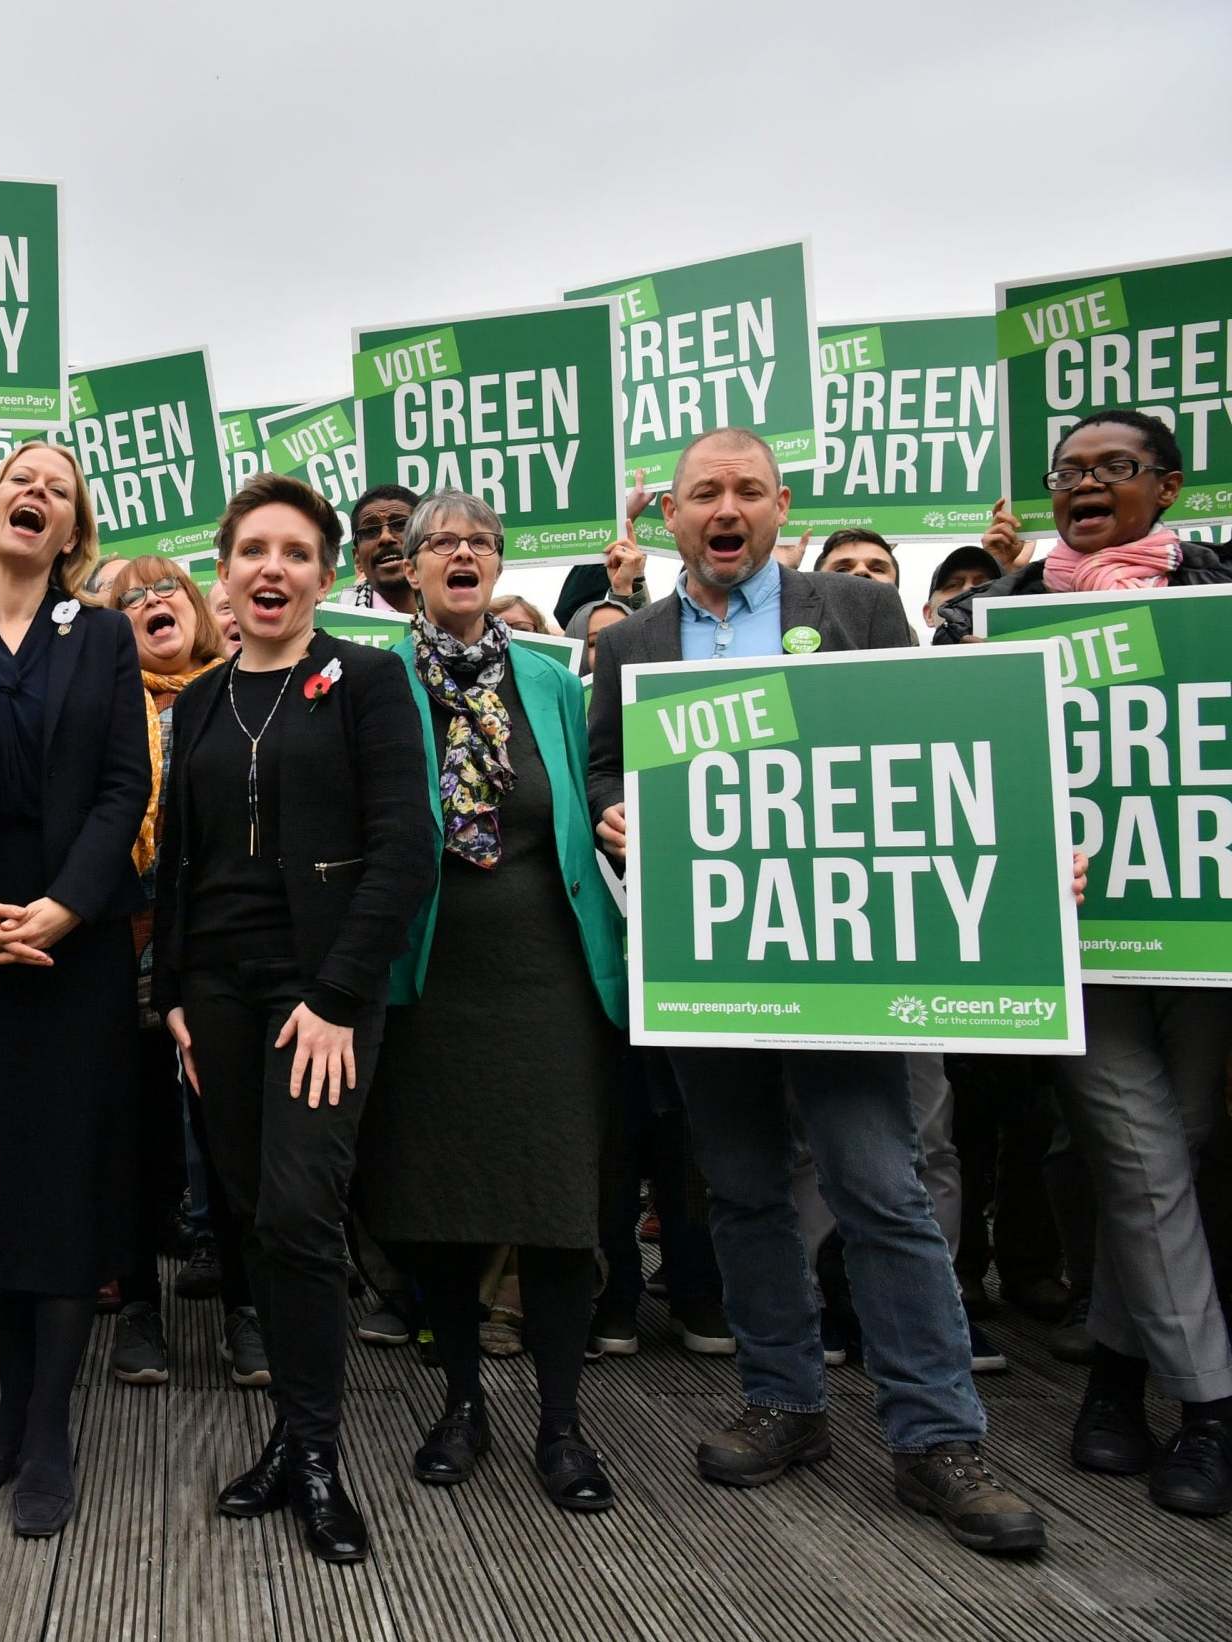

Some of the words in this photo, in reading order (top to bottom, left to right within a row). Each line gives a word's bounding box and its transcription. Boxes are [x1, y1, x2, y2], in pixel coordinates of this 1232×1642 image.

[1022, 290, 1110, 345] VOTE
[373, 338, 447, 387] VOTE
[1045, 319, 1232, 411] GREE
[26, 394, 56, 409] Party
[392, 365, 580, 451] GREEN
[622, 361, 776, 446] ARTY
[823, 365, 997, 433] GREEN
[281, 414, 344, 463] VOTE
[776, 438, 809, 451] Party
[812, 431, 995, 496] PARTY
[396, 439, 580, 515] PARTY
[175, 534, 202, 544] Green
[540, 532, 577, 543] Green
[579, 528, 612, 541] Party
[948, 511, 983, 521] Green
[657, 688, 775, 755] VOTE
[687, 740, 998, 851] GREEN
[691, 854, 998, 962] PARTY
[657, 1000, 801, 1016] www.greenparty.org.uk
[931, 996, 995, 1014] Green
[999, 997, 1057, 1020] Party
[935, 1016, 948, 1025] for
[951, 1016, 967, 1025] the
[969, 1017, 1013, 1026] common
[1015, 1018, 1040, 1028] good
